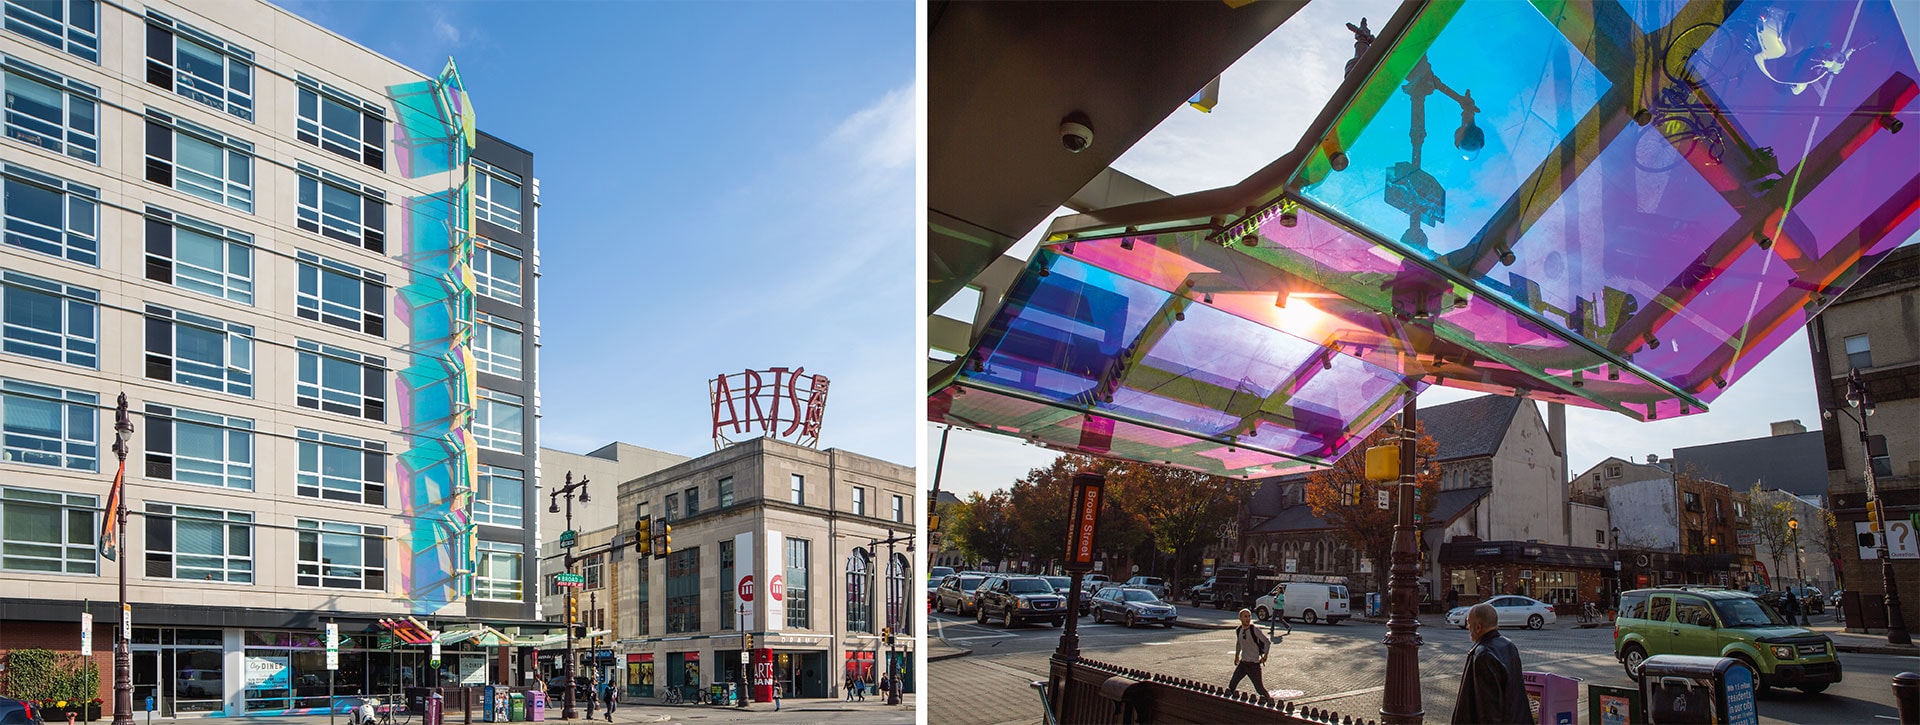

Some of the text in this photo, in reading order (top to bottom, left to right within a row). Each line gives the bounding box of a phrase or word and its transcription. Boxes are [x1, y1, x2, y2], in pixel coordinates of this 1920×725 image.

[712, 366, 804, 438] ARTS
[803, 374, 829, 438] BANK
[1081, 491, 1096, 556] Broad Street
[754, 663, 773, 678] ARTS
[1728, 691, 1751, 703] residents
[1734, 704, 1742, 712] our
[1743, 702, 1752, 711] city
